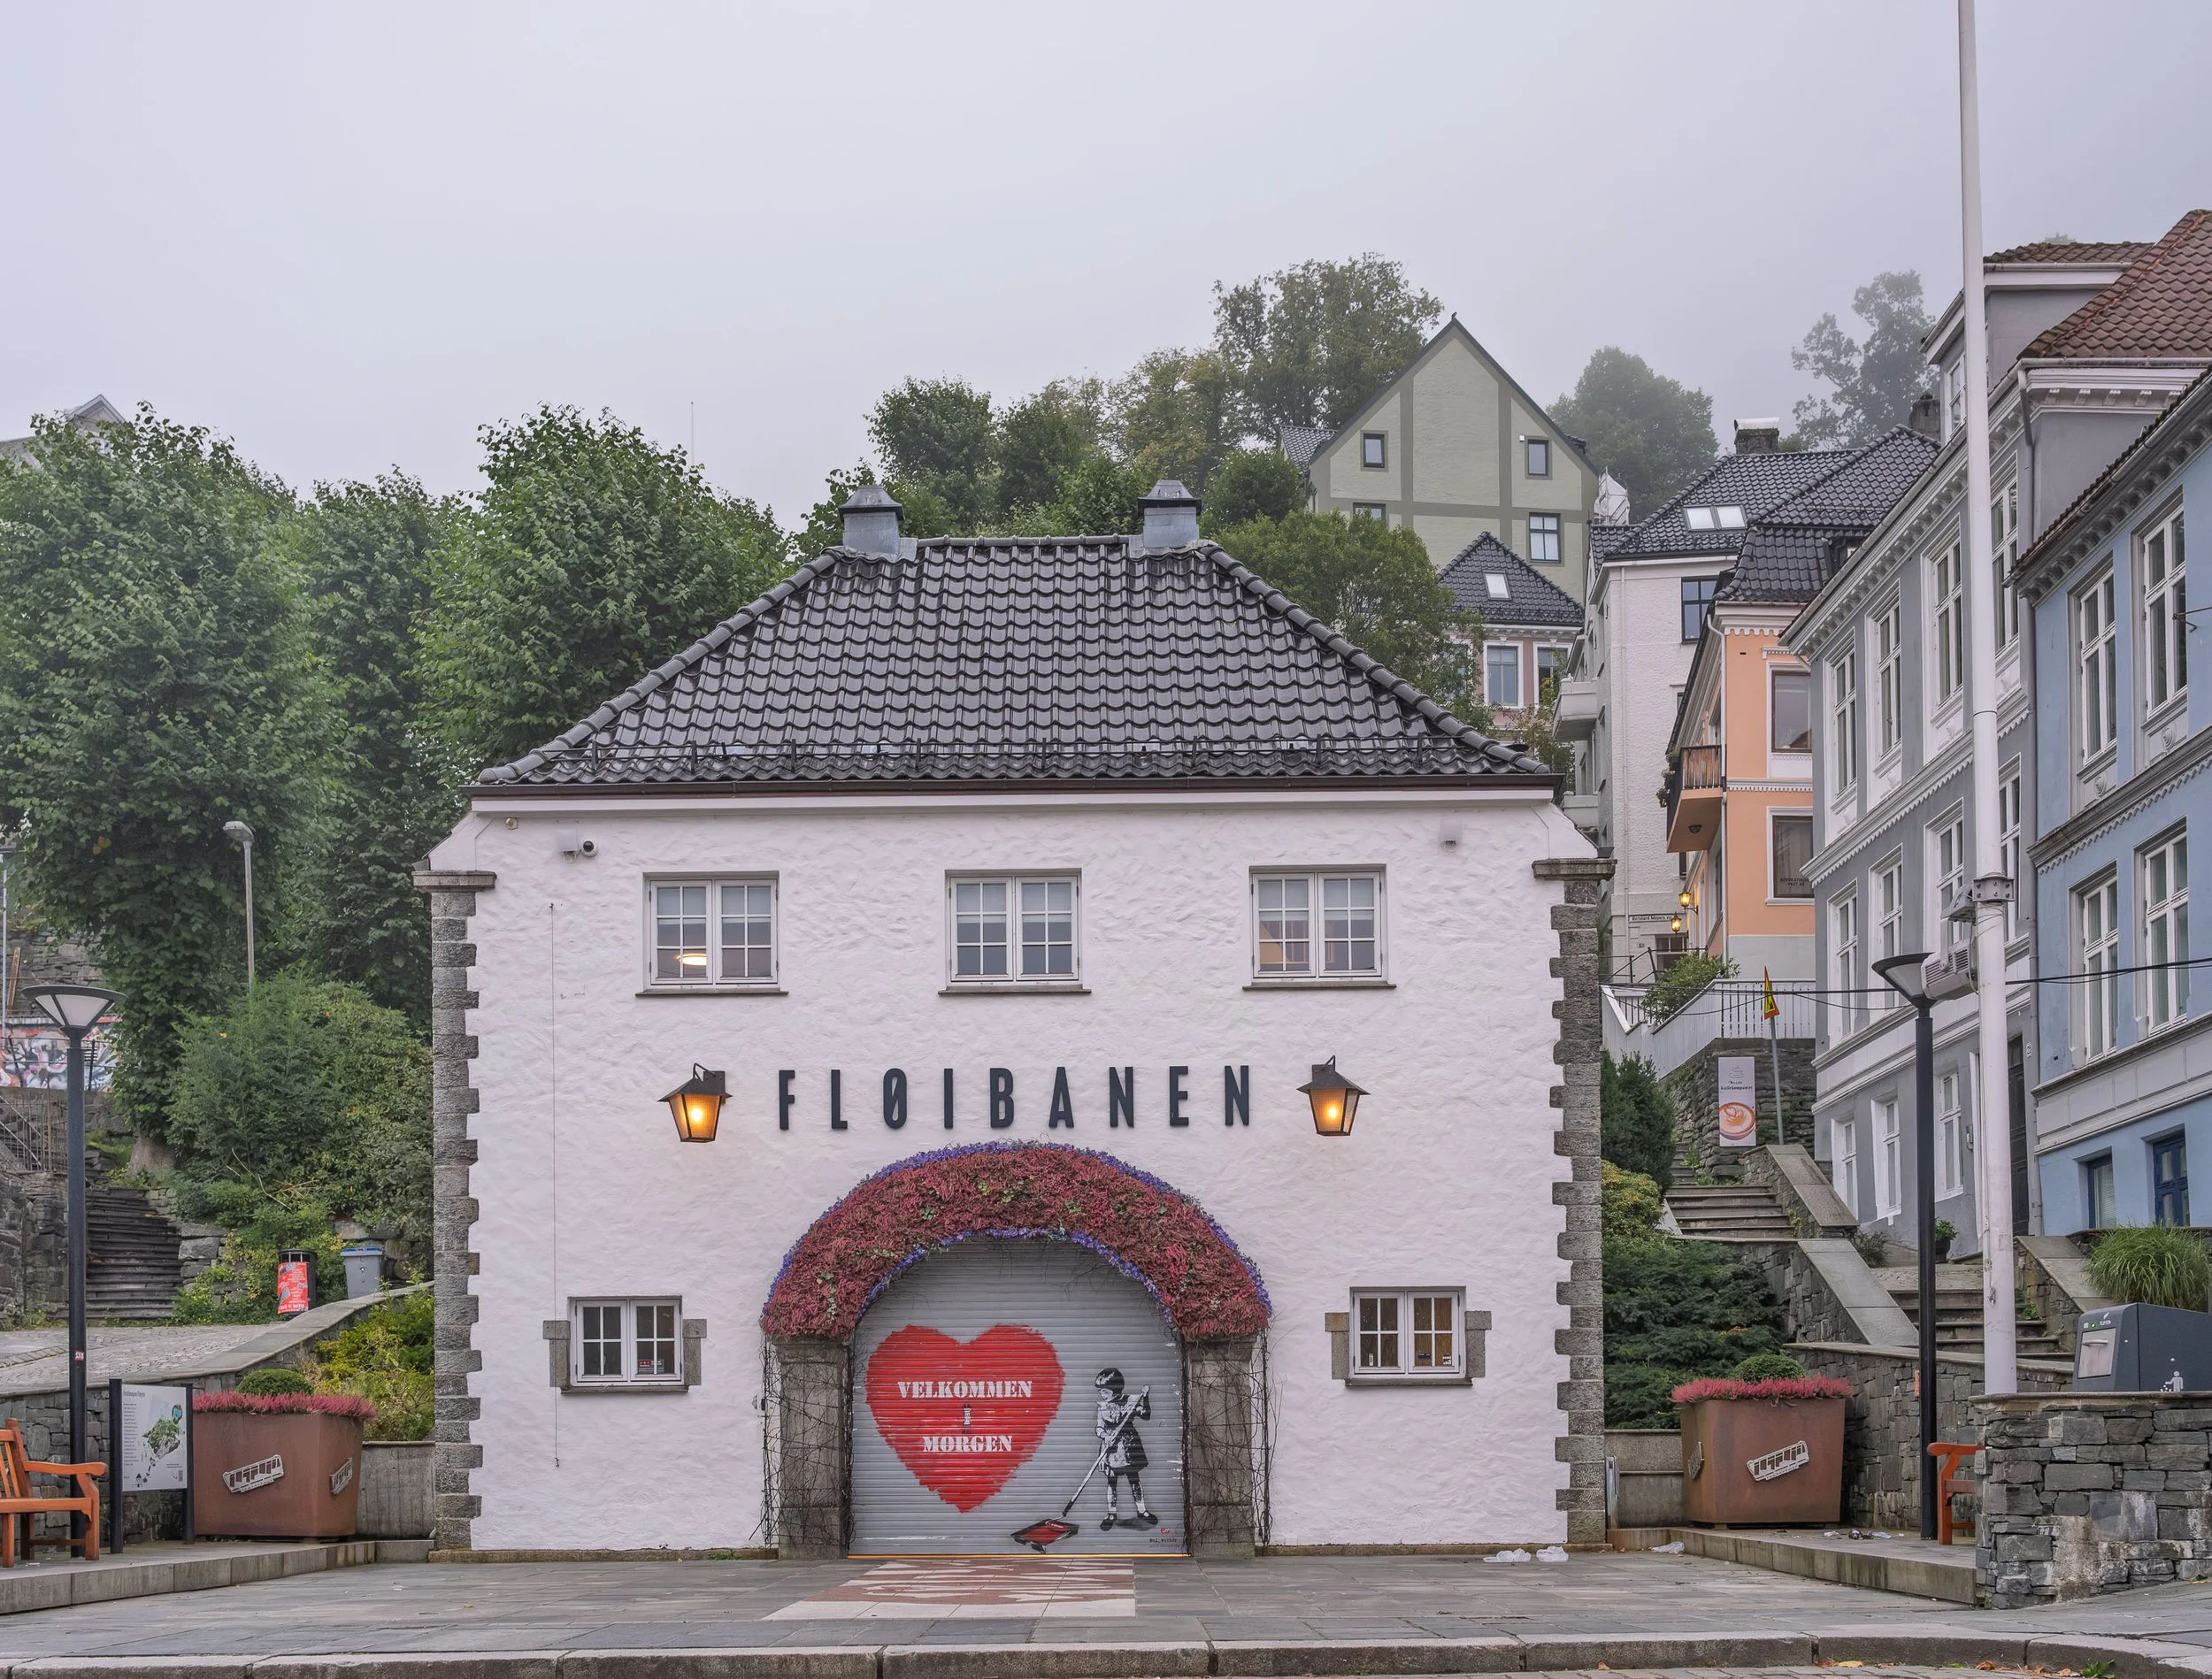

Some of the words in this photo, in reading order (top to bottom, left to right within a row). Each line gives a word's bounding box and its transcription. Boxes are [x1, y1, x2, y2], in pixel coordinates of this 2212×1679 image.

[779, 1064, 1249, 1131] FLØIBANEN
[897, 1380, 1033, 1399] VELKOMMEN
[922, 1435, 1013, 1453] MORGEN
